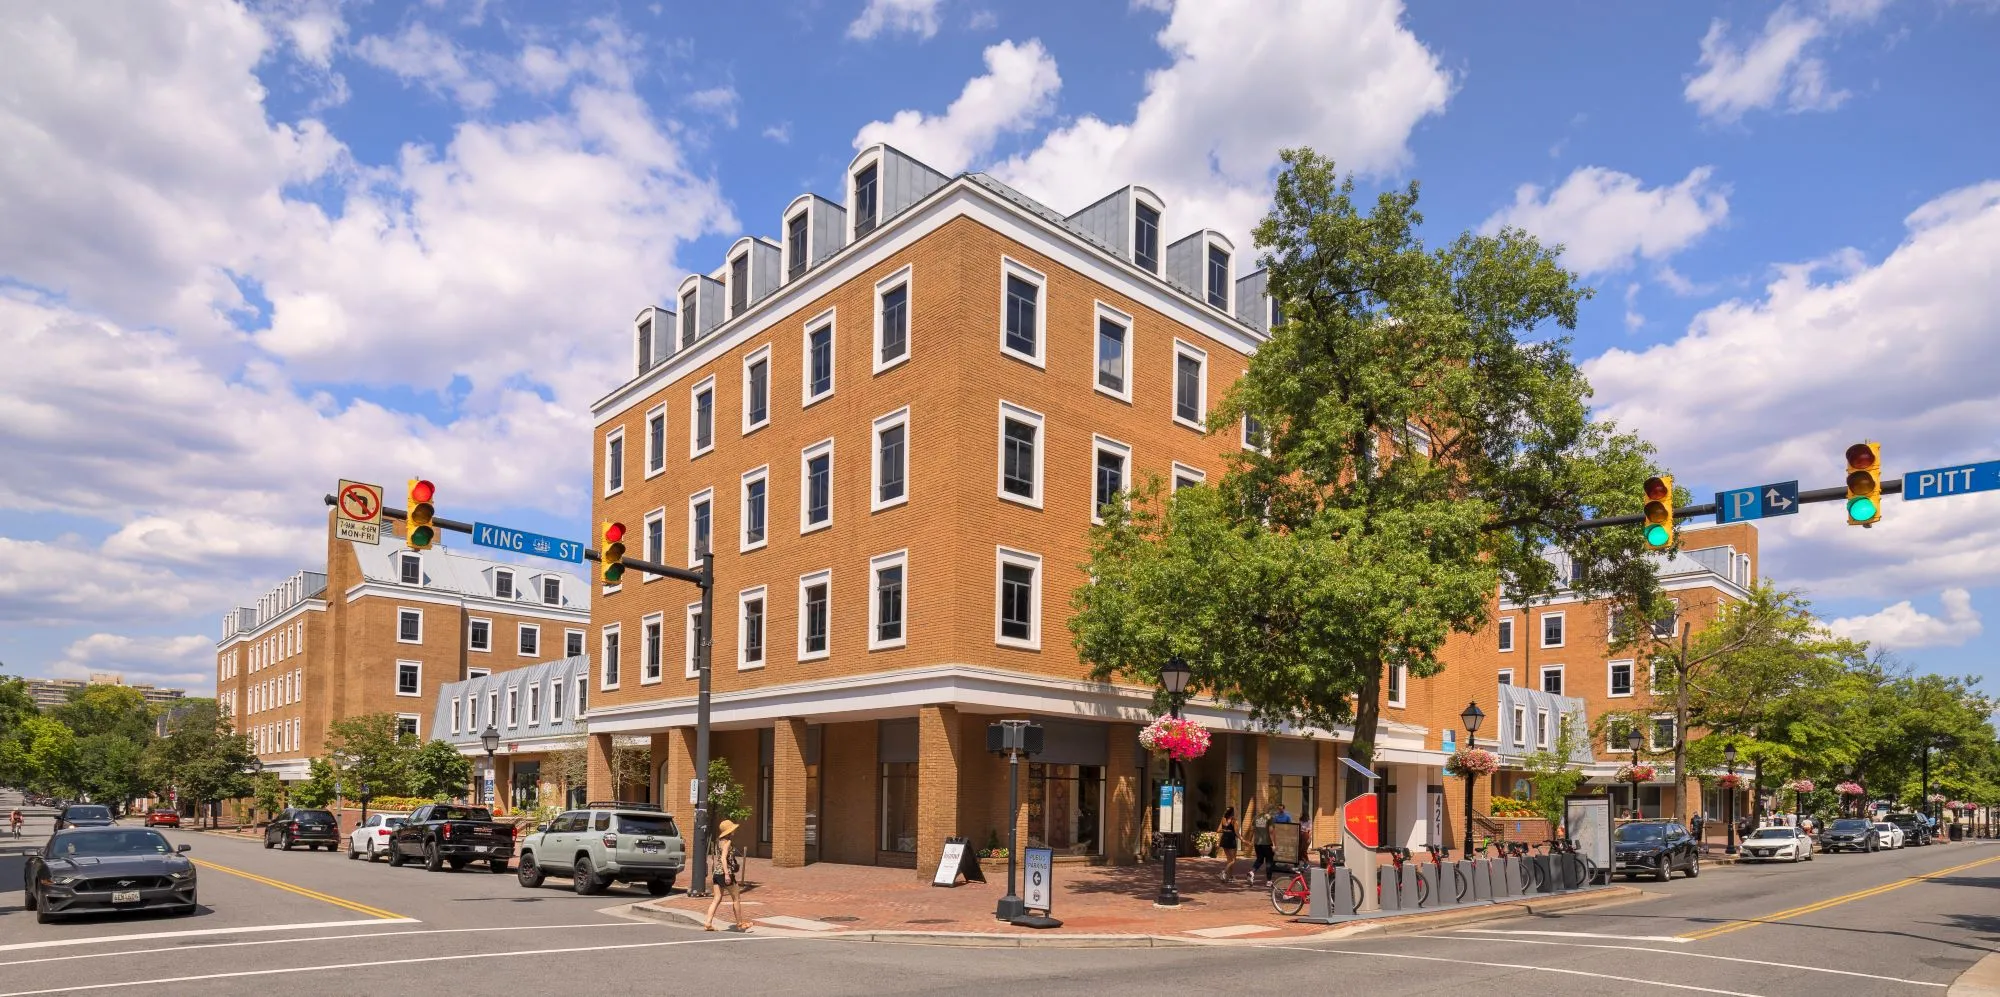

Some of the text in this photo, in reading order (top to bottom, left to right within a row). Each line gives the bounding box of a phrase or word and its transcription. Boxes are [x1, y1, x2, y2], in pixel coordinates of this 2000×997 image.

[1918, 467, 1975, 496] PITT
[1730, 491, 1755, 520] P
[341, 529, 375, 541] MON-FRI
[481, 526, 579, 560] KING ST
